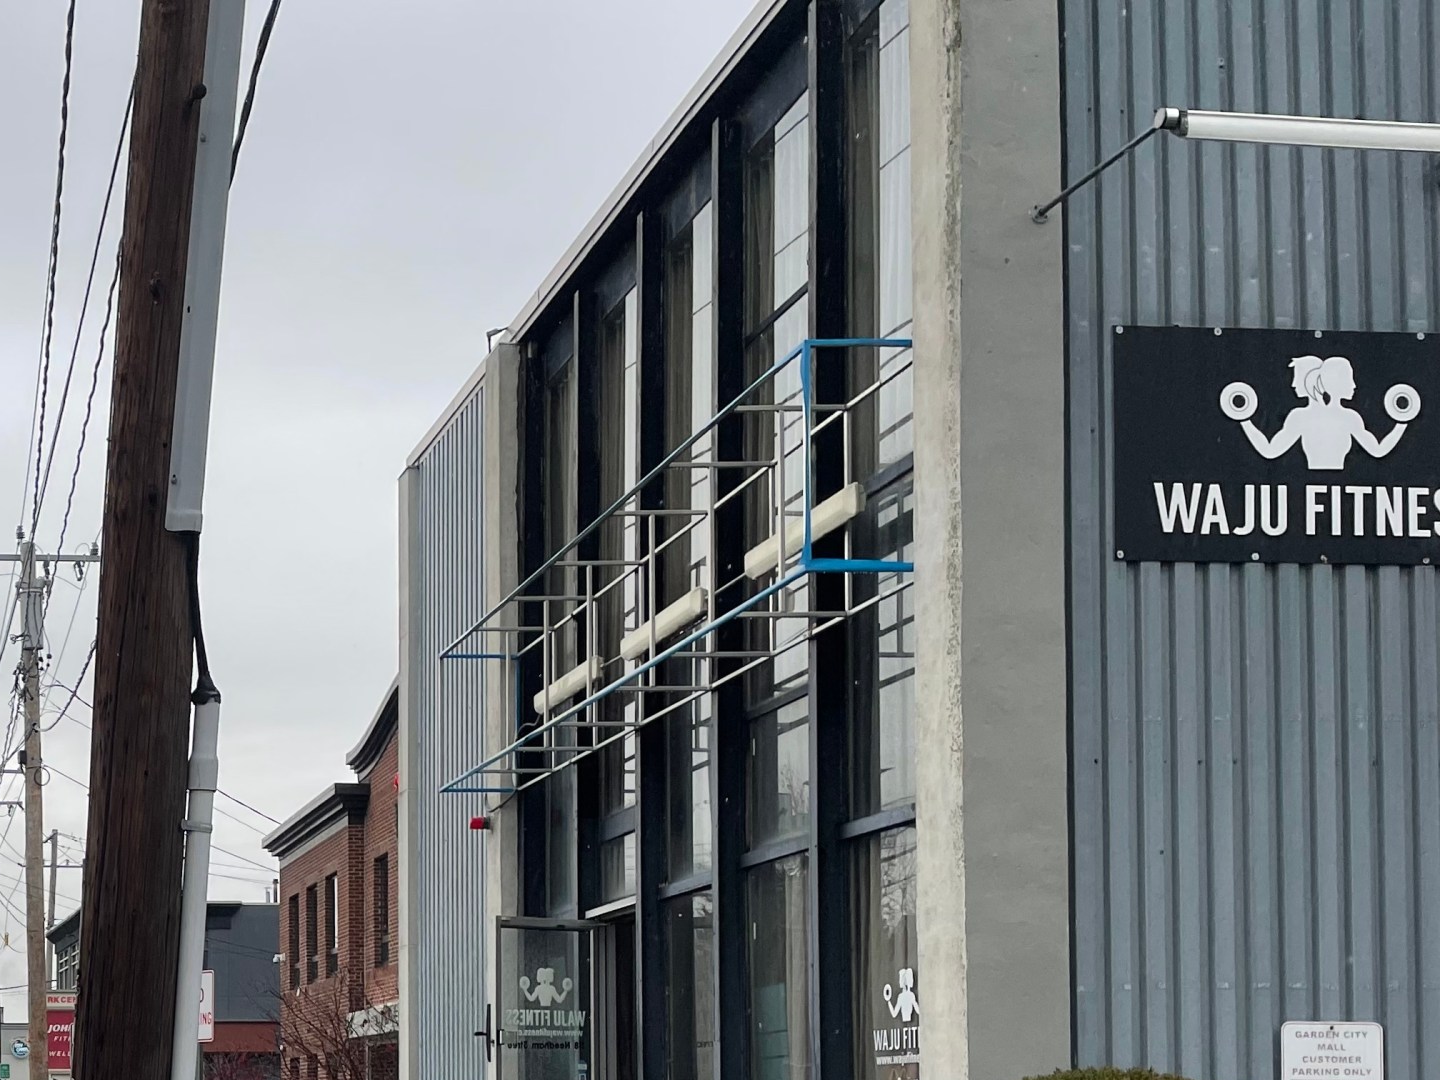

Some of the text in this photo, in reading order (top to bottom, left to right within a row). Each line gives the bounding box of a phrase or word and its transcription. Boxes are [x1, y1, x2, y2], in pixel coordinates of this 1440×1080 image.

[1153, 482, 1440, 538] WAJU FITNE
[873, 1026, 919, 1051] WAJU FIT
[1295, 1030, 1368, 1039] GARDEN CITY
[1317, 1043, 1346, 1051] MALL
[1302, 1055, 1362, 1064] CUSTOMER
[1292, 1068, 1372, 1076] PARKING ONLY
